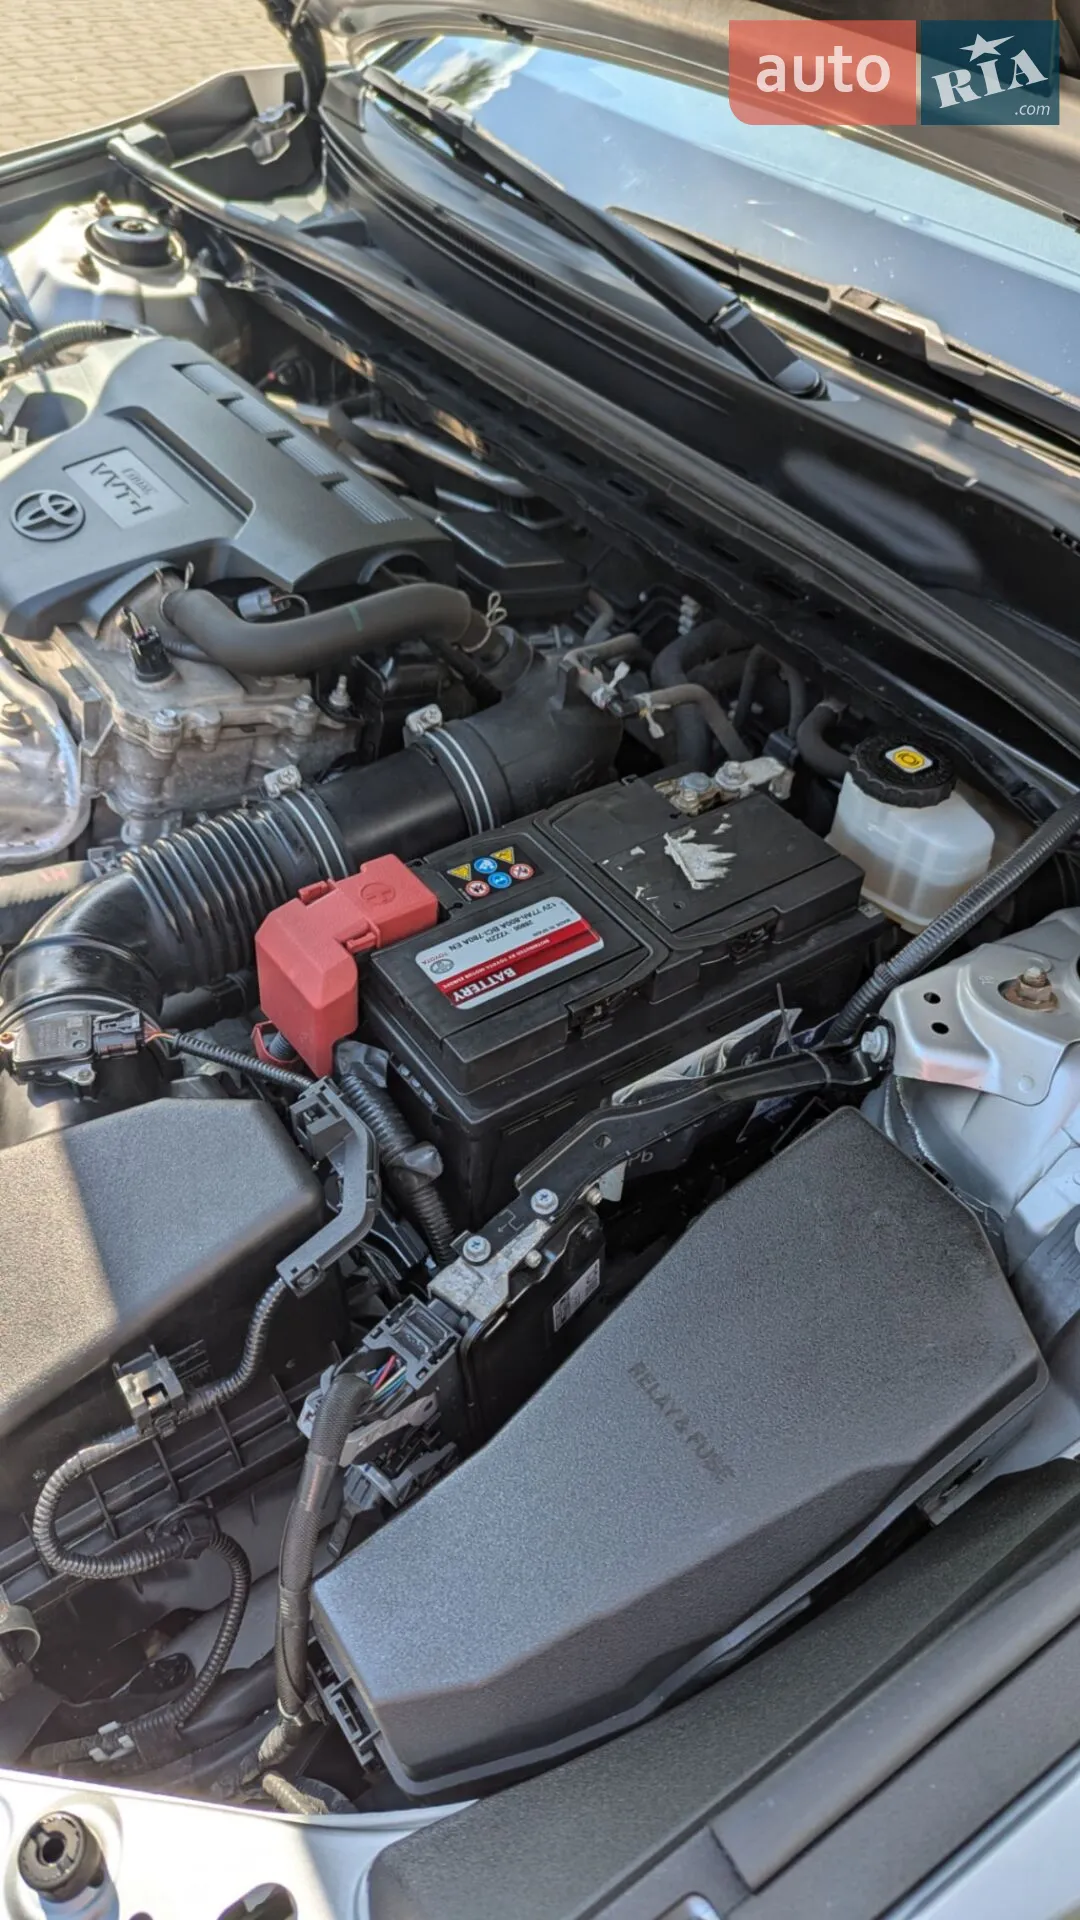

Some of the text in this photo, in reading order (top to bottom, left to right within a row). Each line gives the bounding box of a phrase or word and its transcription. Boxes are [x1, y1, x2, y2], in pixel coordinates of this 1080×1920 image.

[448, 941, 463, 951] EN
[421, 951, 448, 965] TOYOTA
[452, 968, 516, 1001] BATTERY
[627, 1361, 683, 1416] RELAY
[674, 1417, 690, 1434] &
